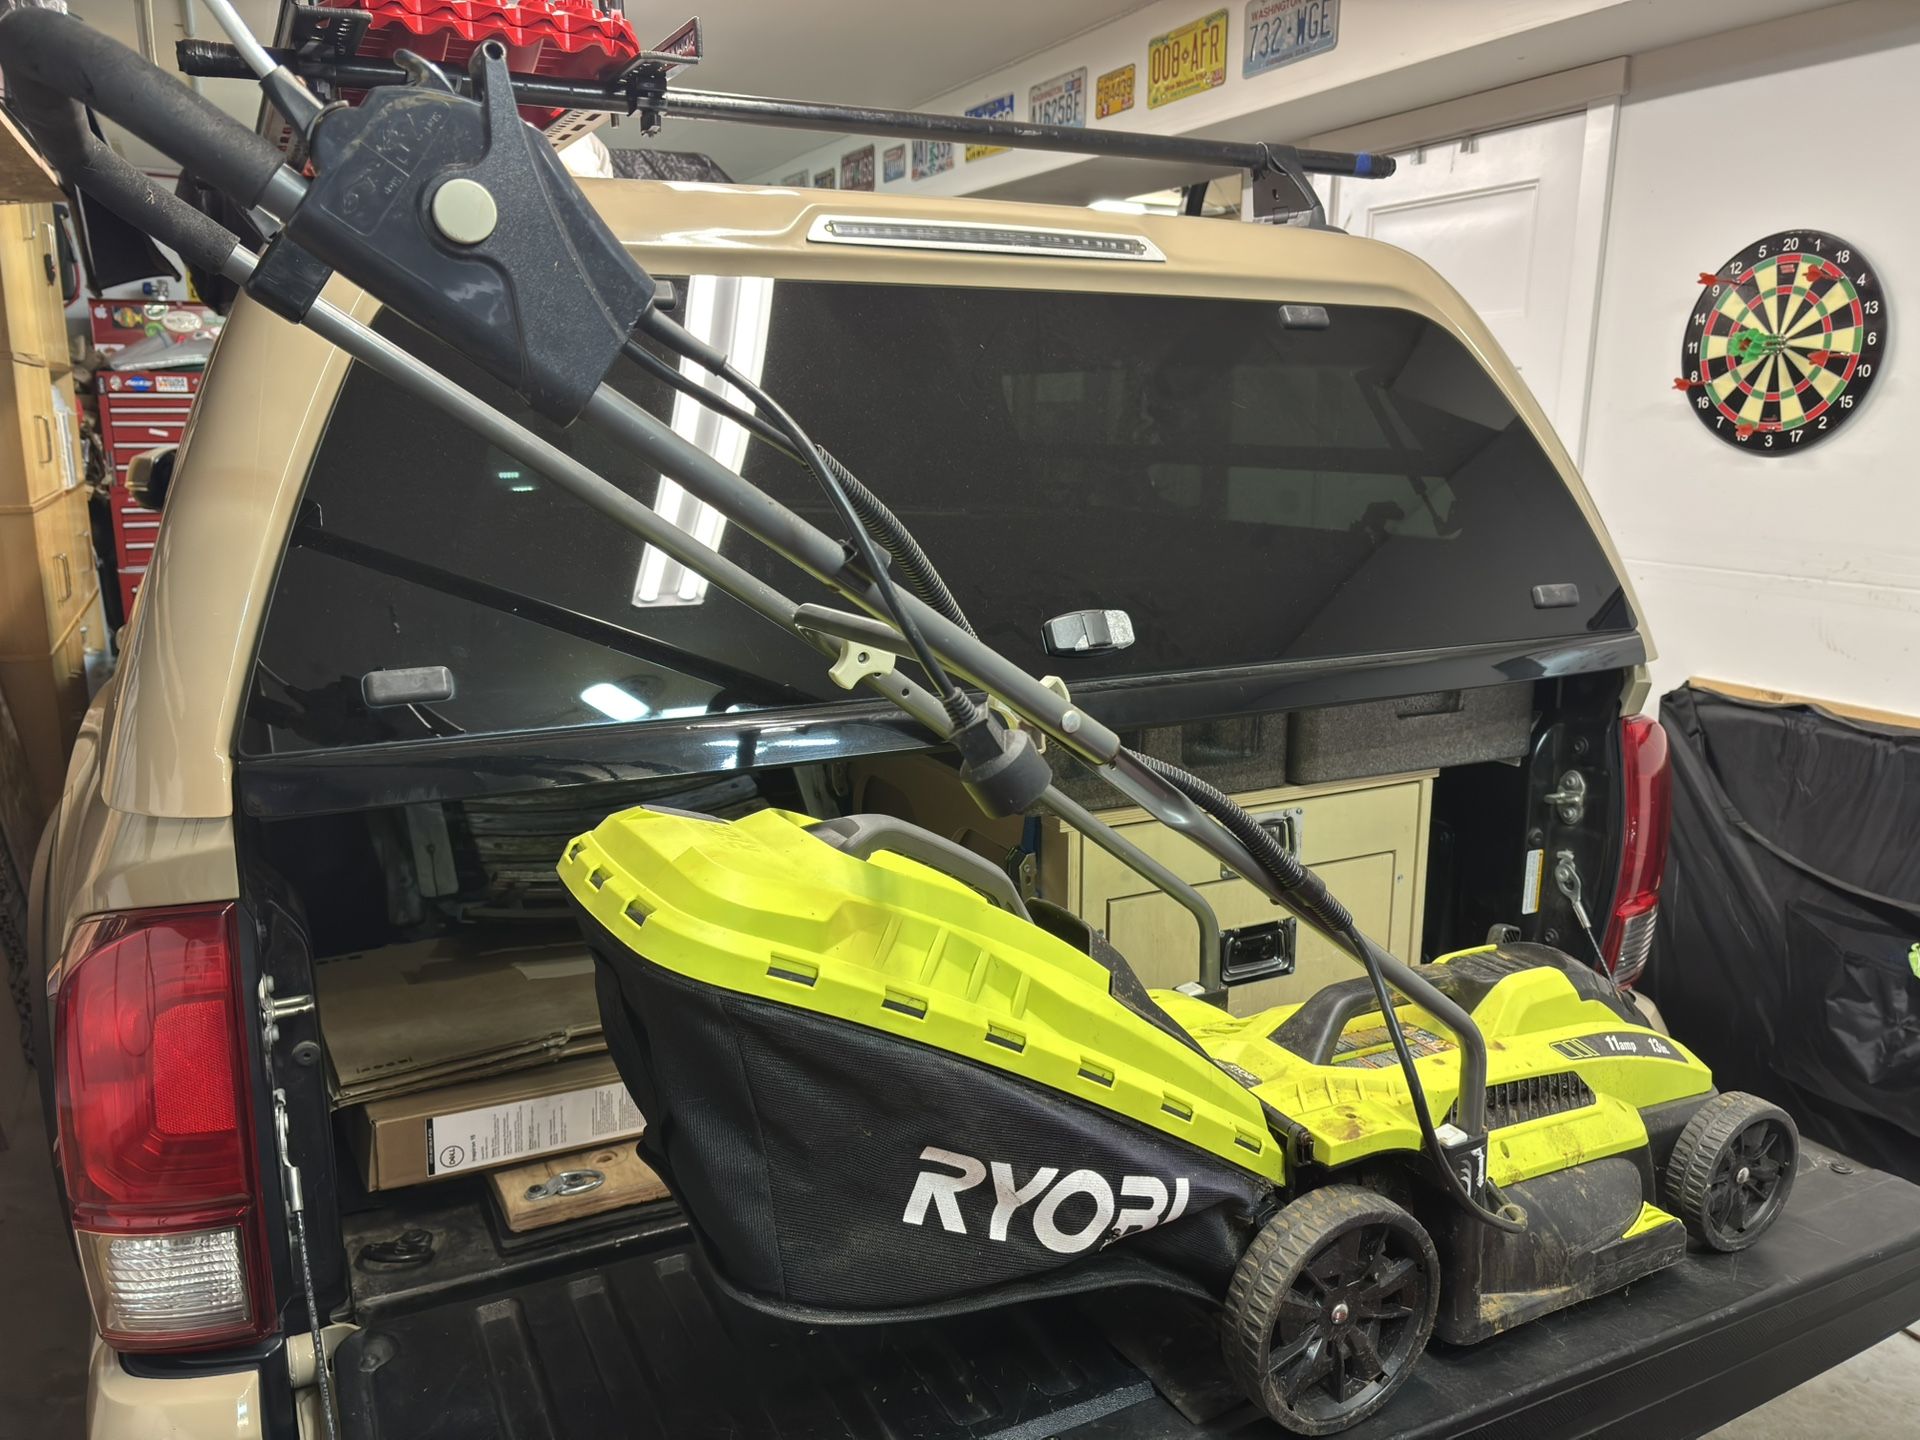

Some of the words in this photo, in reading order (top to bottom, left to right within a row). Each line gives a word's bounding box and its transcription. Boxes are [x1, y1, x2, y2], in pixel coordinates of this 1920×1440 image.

[1191, 24, 1220, 72] AFR
[1783, 238, 1799, 251] 20
[1814, 239, 1821, 251] 1
[1758, 245, 1767, 258] 5
[1836, 250, 1850, 263] 18
[1730, 262, 1743, 274] 12
[1856, 273, 1866, 286] 4
[1712, 285, 1720, 297] 9
[1864, 301, 1879, 314] 13
[1694, 313, 1706, 325] 14
[1867, 332, 1877, 345] 6
[1688, 342, 1698, 354] 11
[1690, 371, 1698, 382] 8
[1857, 364, 1871, 377] 10
[1696, 396, 1709, 409] 16
[1839, 395, 1853, 408] 15
[1716, 416, 1724, 429] 7
[1818, 416, 1827, 429] 2
[1764, 435, 1773, 447] 3
[1789, 430, 1803, 443] 17
[903, 1146, 1190, 1252] RYOBI
